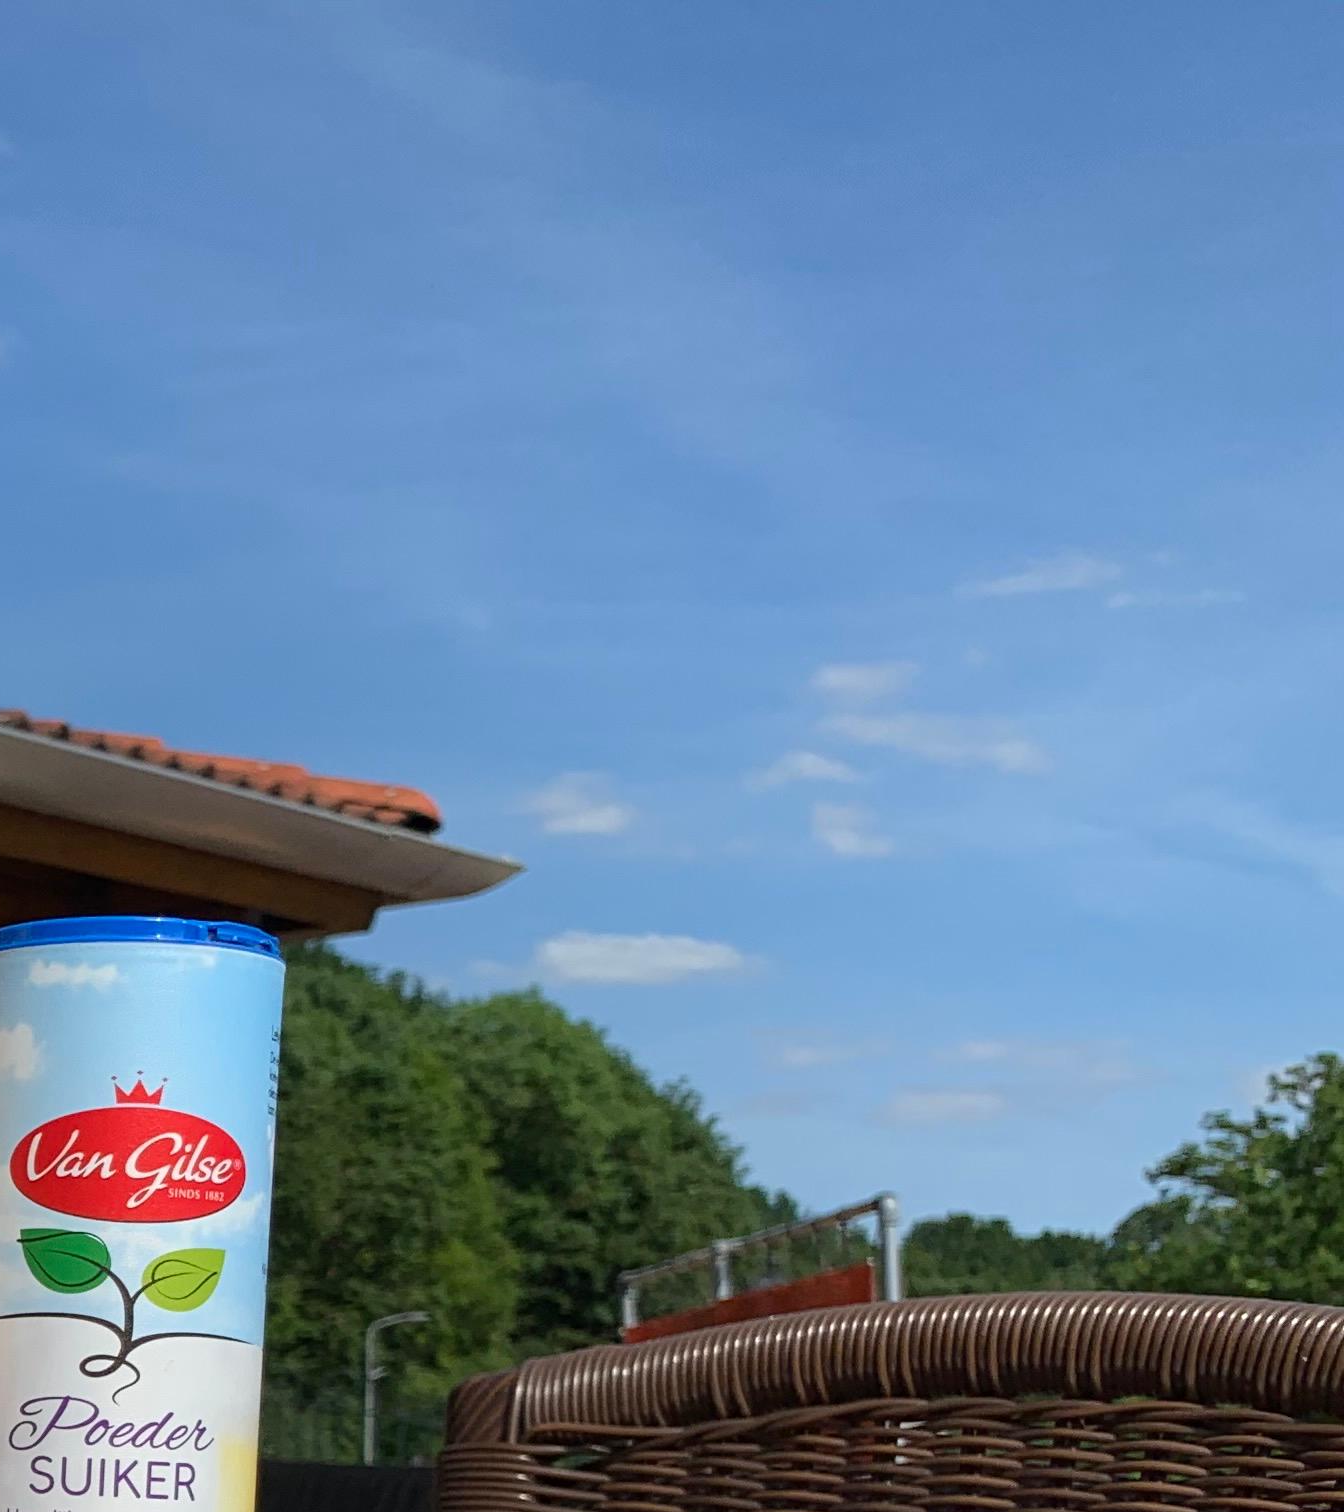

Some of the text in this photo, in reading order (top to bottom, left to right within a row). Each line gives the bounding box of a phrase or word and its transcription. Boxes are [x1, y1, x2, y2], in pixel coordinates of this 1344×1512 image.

[26, 1129, 234, 1209] Van Gilse
[168, 1187, 200, 1200] SINDS
[9, 1395, 215, 1451] Poeder
[29, 1455, 196, 1502] SUIKER
